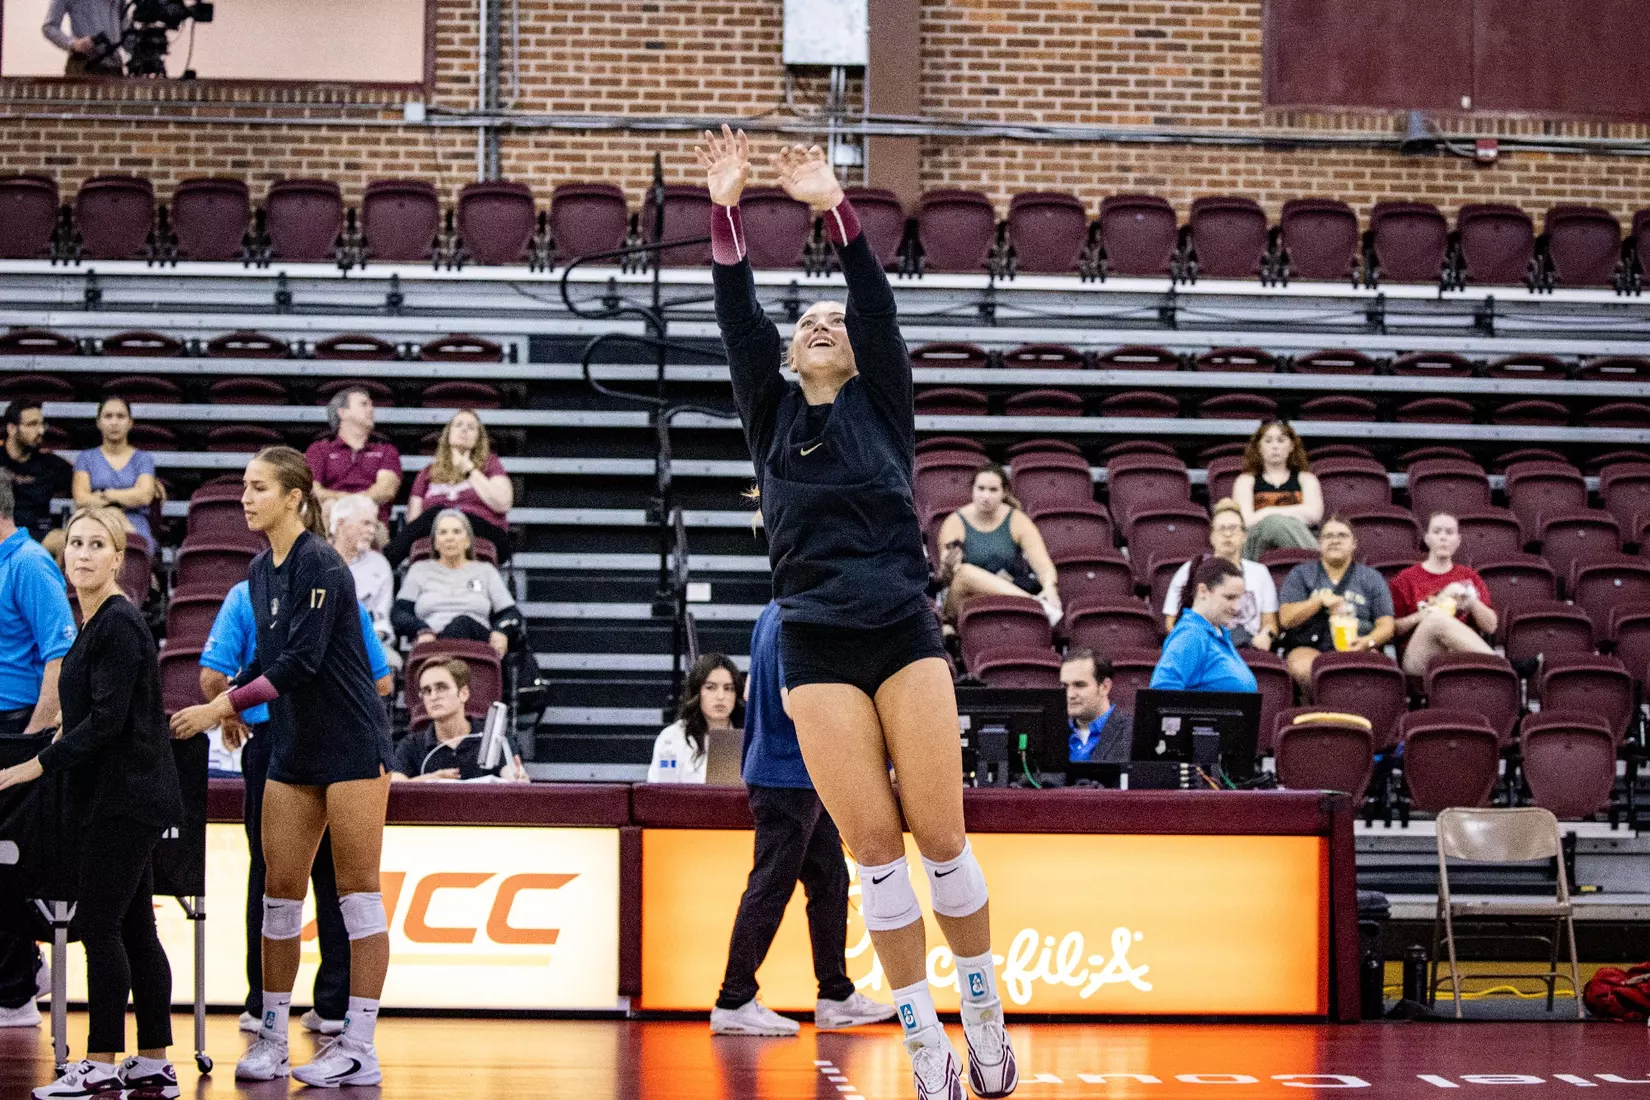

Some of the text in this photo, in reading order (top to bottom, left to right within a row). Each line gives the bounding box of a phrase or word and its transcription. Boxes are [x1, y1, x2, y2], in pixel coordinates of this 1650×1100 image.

[310, 588, 327, 609] 17
[846, 884, 1152, 1005] c-fil-A
[960, 1073, 1372, 1089] Cour
